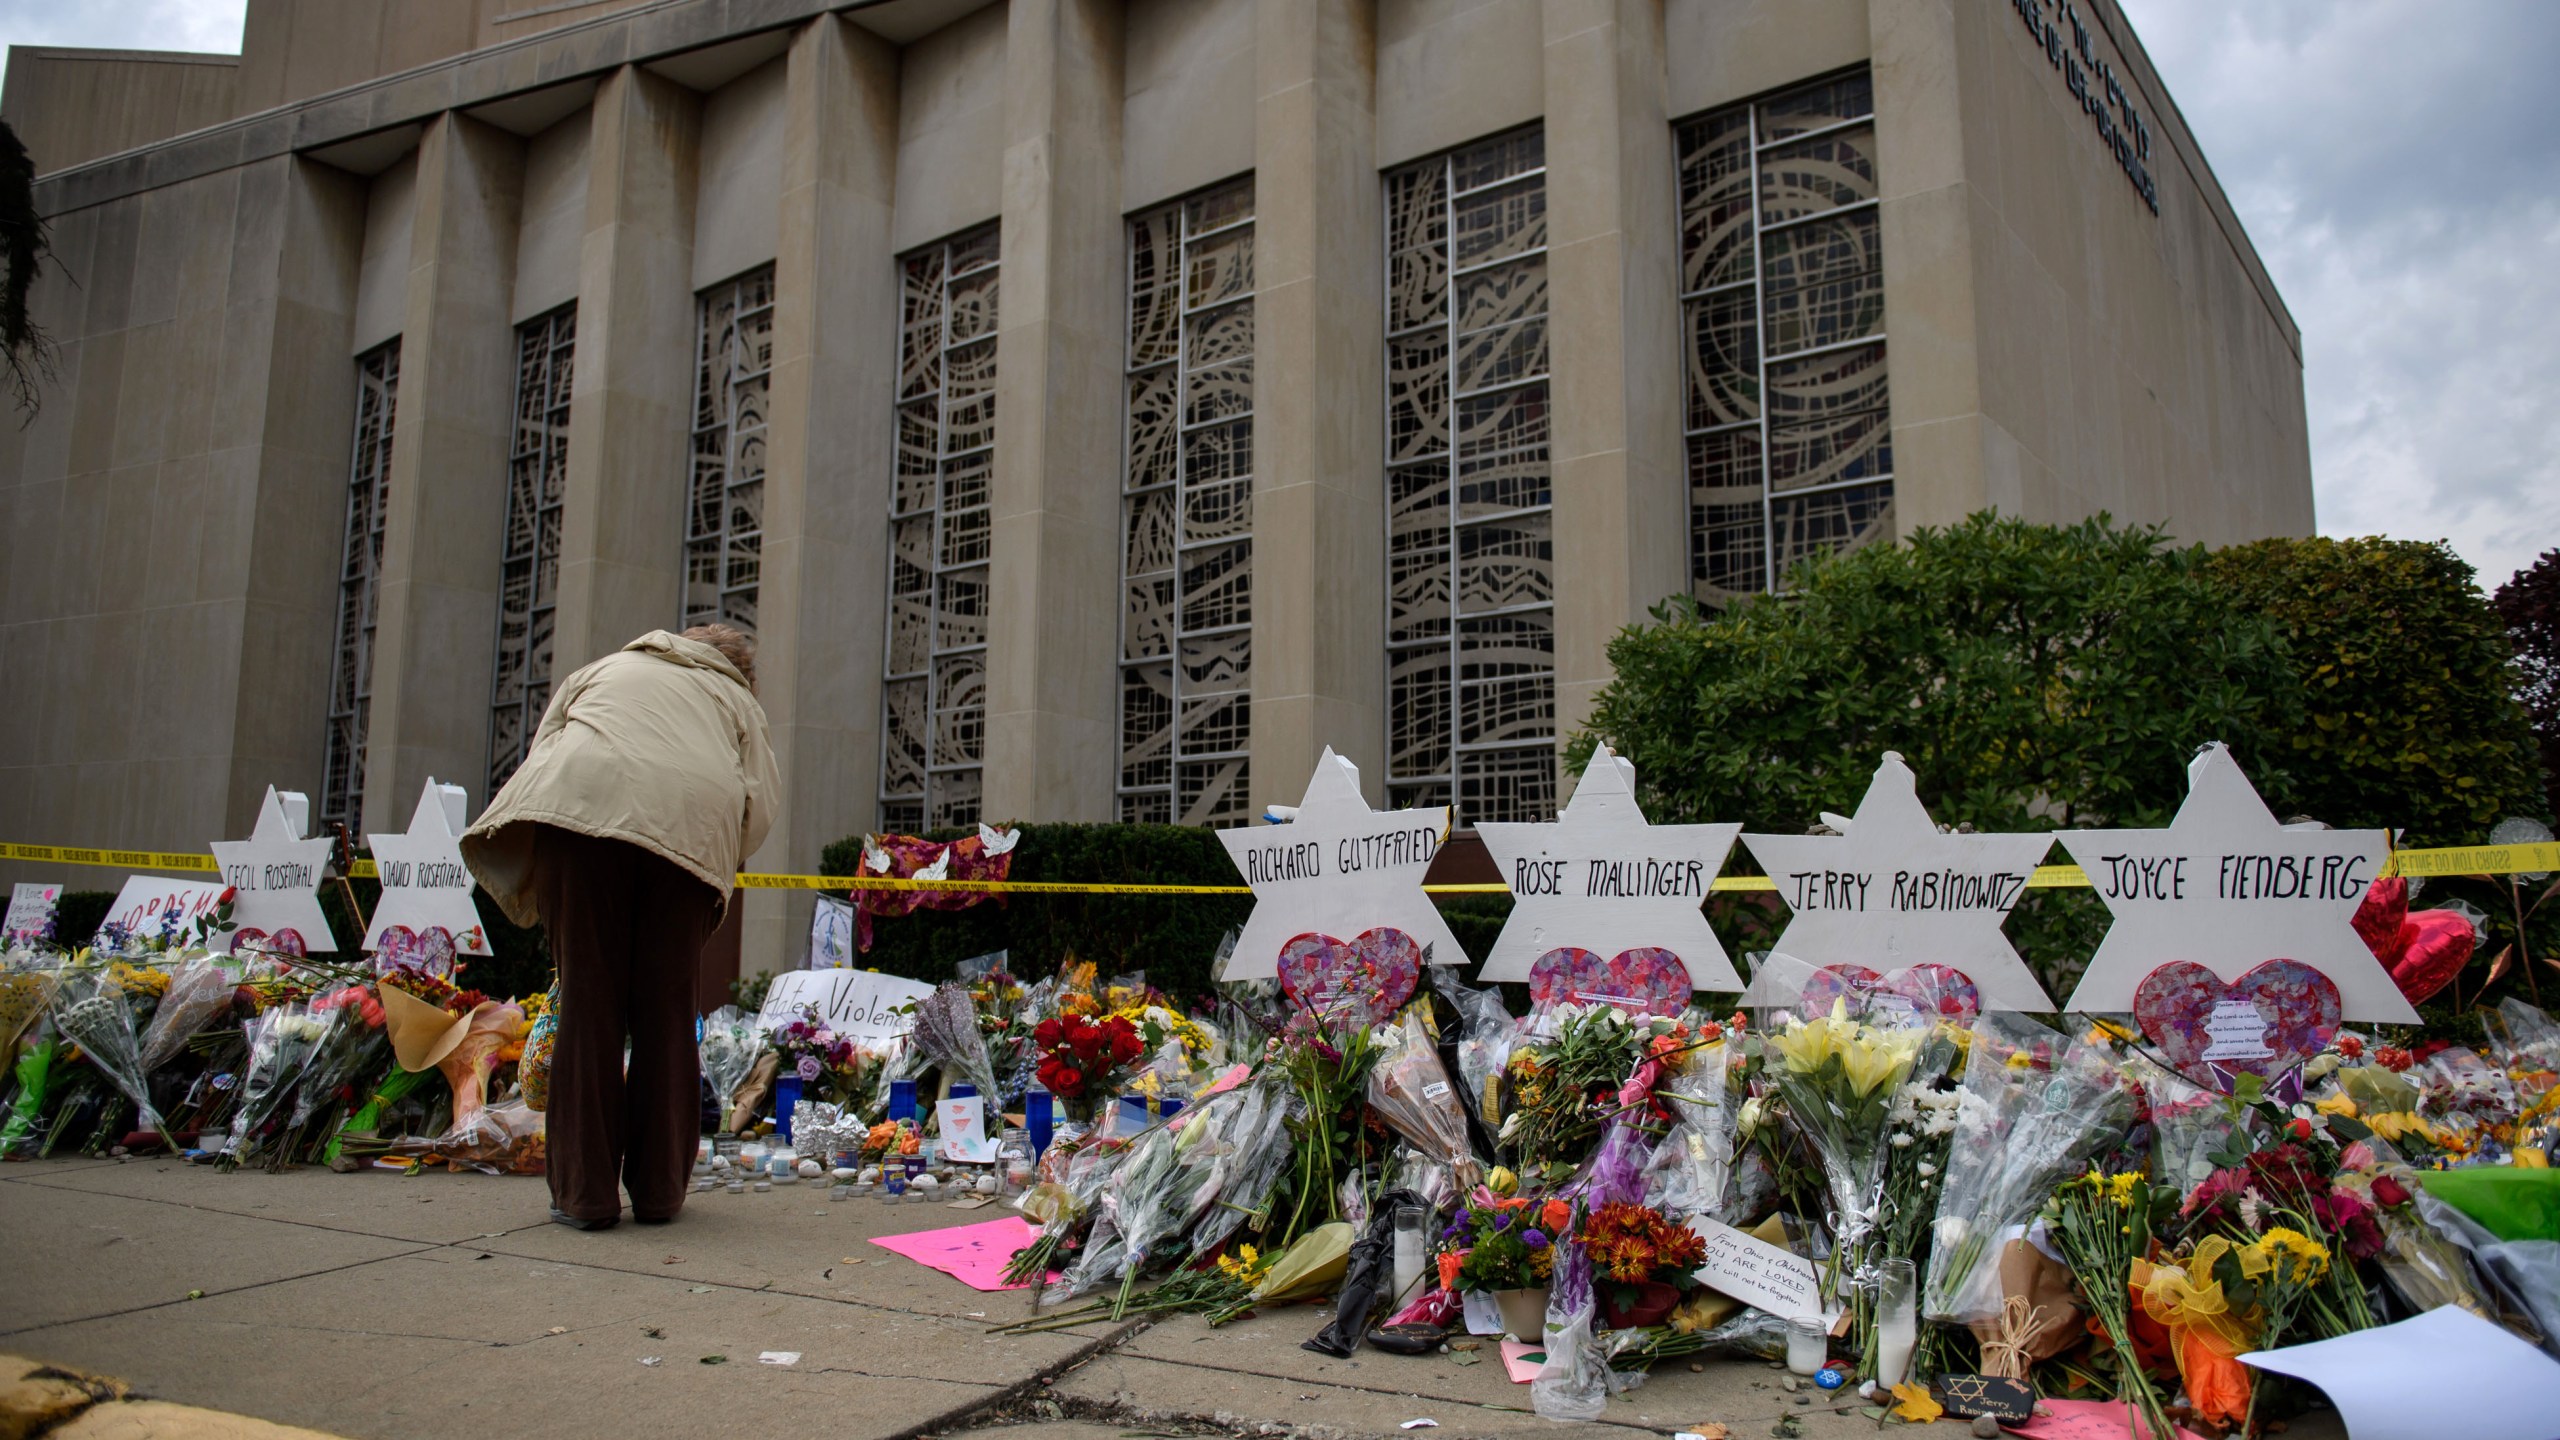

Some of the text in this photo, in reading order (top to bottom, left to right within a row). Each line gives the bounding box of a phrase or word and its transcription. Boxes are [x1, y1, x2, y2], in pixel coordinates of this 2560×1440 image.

[2045, 22, 2063, 71] OF
[227, 863, 313, 891] CECIL ROSENTHAL
[383, 860, 467, 888] DAVID ROSENTHAL
[1515, 857, 1704, 897] ROSE MALLINGER
[1789, 869, 2026, 912] JERRY RABINOWITZ
[2101, 854, 2188, 900] JOYCE
[2219, 855, 2369, 900] FIENBERG
[1713, 1232, 1738, 1251] From
[1743, 1246, 1764, 1261] Ohio
[1703, 1246, 1805, 1292] OU ARE LOVED
[1723, 1268, 1739, 1279] will
[1741, 1277, 1756, 1286] not
[1758, 1282, 1767, 1291] be
[1769, 1286, 1801, 1307] forgotten
[1979, 1397, 2010, 1410] Jerry
